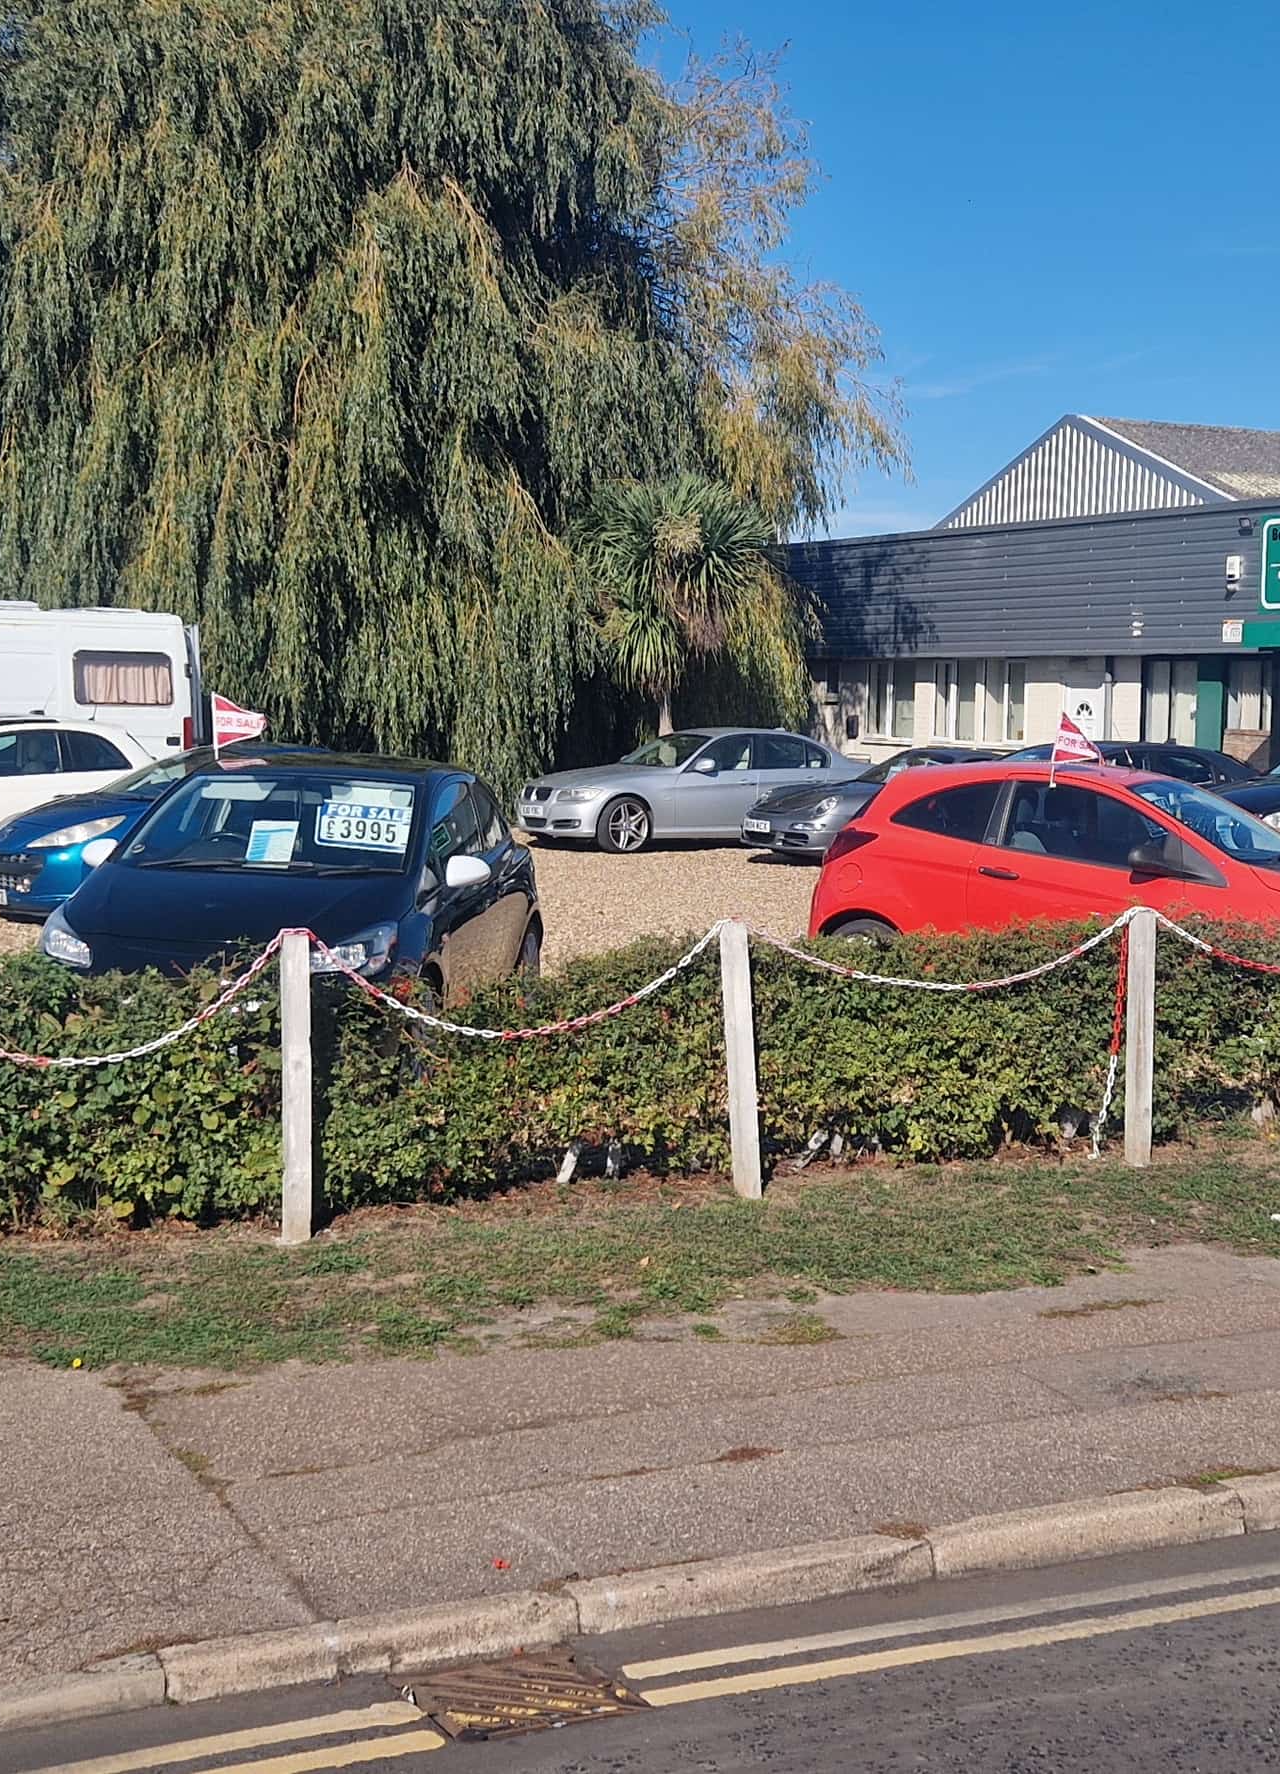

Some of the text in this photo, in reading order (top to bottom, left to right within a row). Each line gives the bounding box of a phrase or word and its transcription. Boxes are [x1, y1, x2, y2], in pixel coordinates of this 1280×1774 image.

[1057, 735, 1076, 748] FOR
[327, 804, 410, 821] FOR SALE
